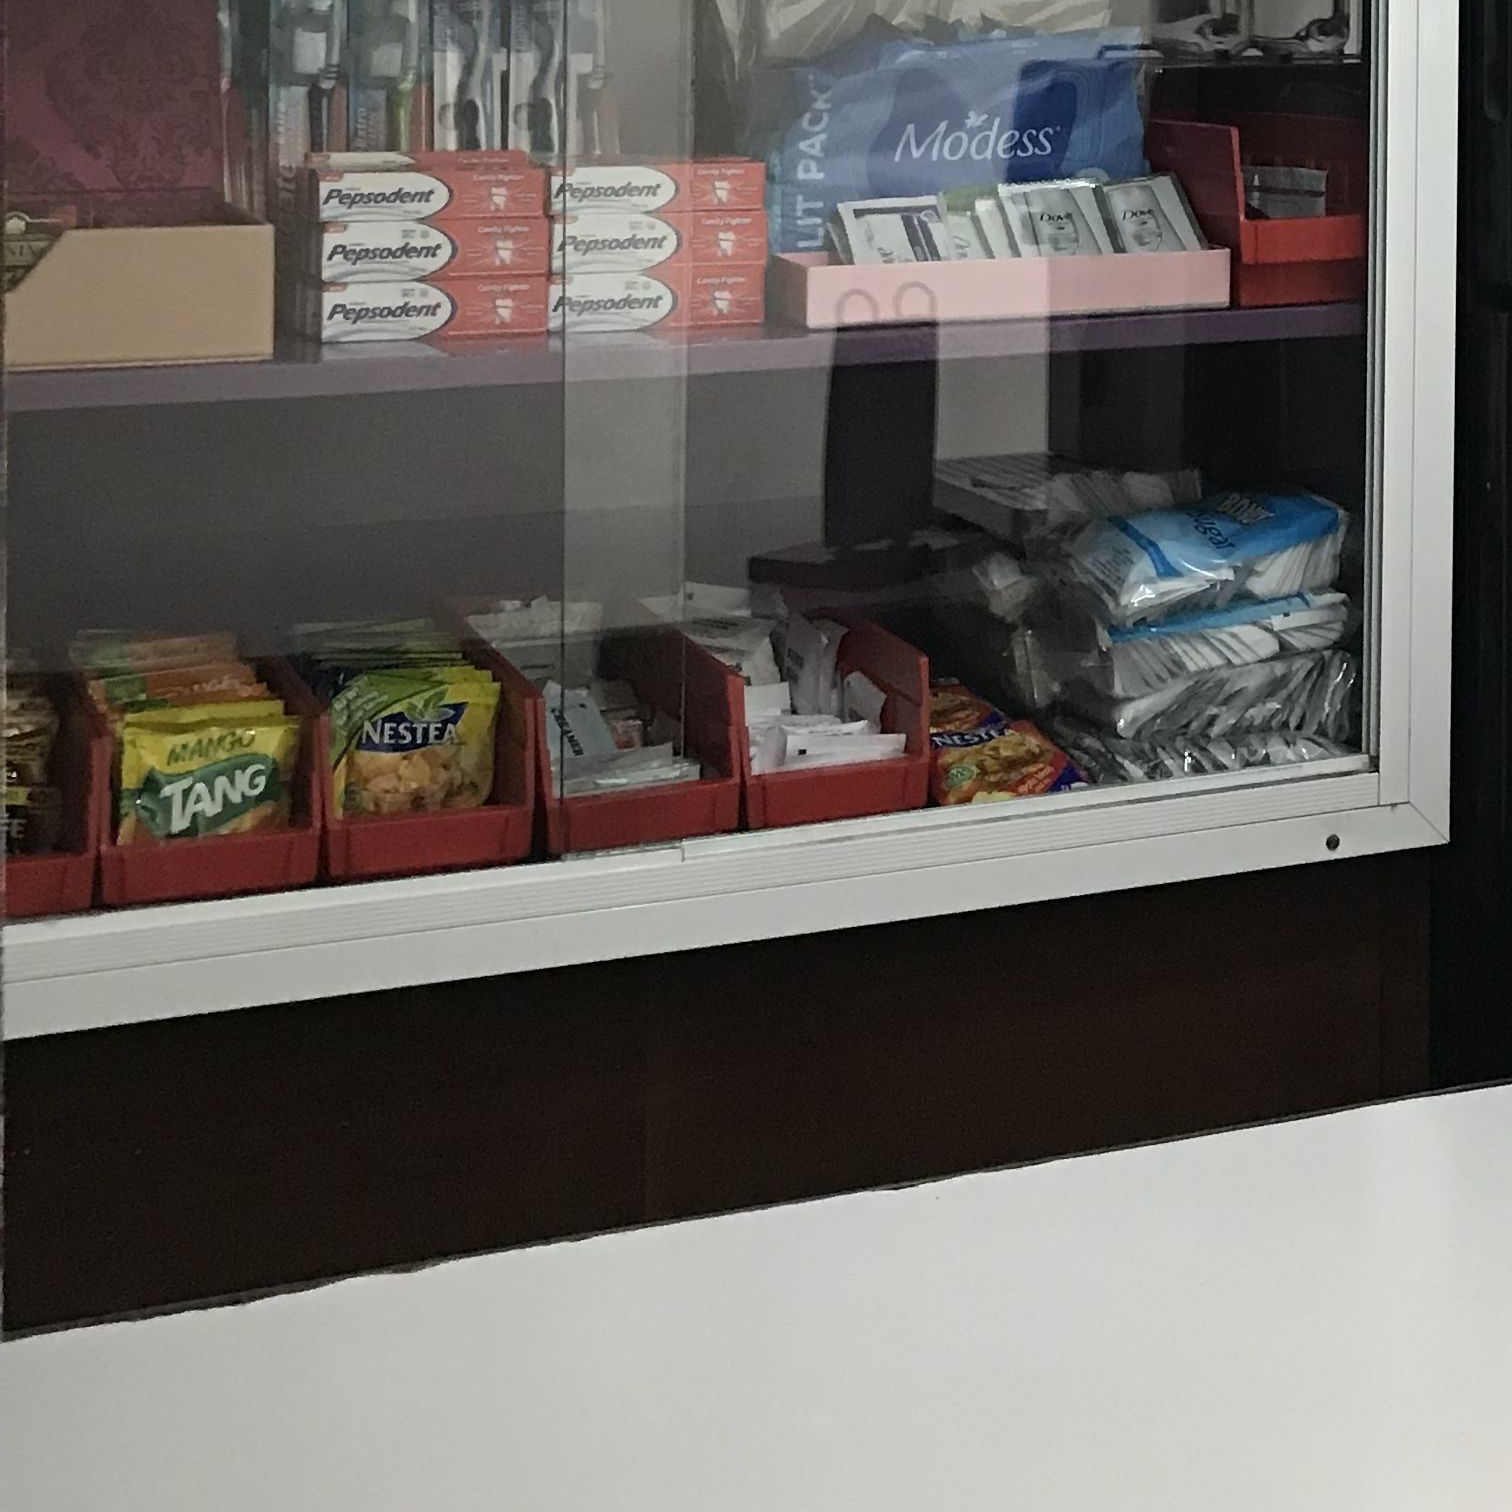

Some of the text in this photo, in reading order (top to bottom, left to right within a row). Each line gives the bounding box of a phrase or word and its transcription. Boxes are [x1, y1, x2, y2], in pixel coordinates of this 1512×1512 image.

[795, 87, 833, 181] PACK
[893, 116, 1055, 163] Modess
[322, 186, 435, 209] Pepsodent
[553, 181, 661, 202] Pepsodent
[327, 242, 442, 266] Pepsodent
[556, 234, 667, 256] Pepsodent
[327, 301, 442, 325] Pepsodent
[551, 293, 663, 316] Pepsodent
[361, 718, 460, 746] NESTEA
[165, 730, 257, 767] MANGO
[159, 763, 267, 835] TANG
